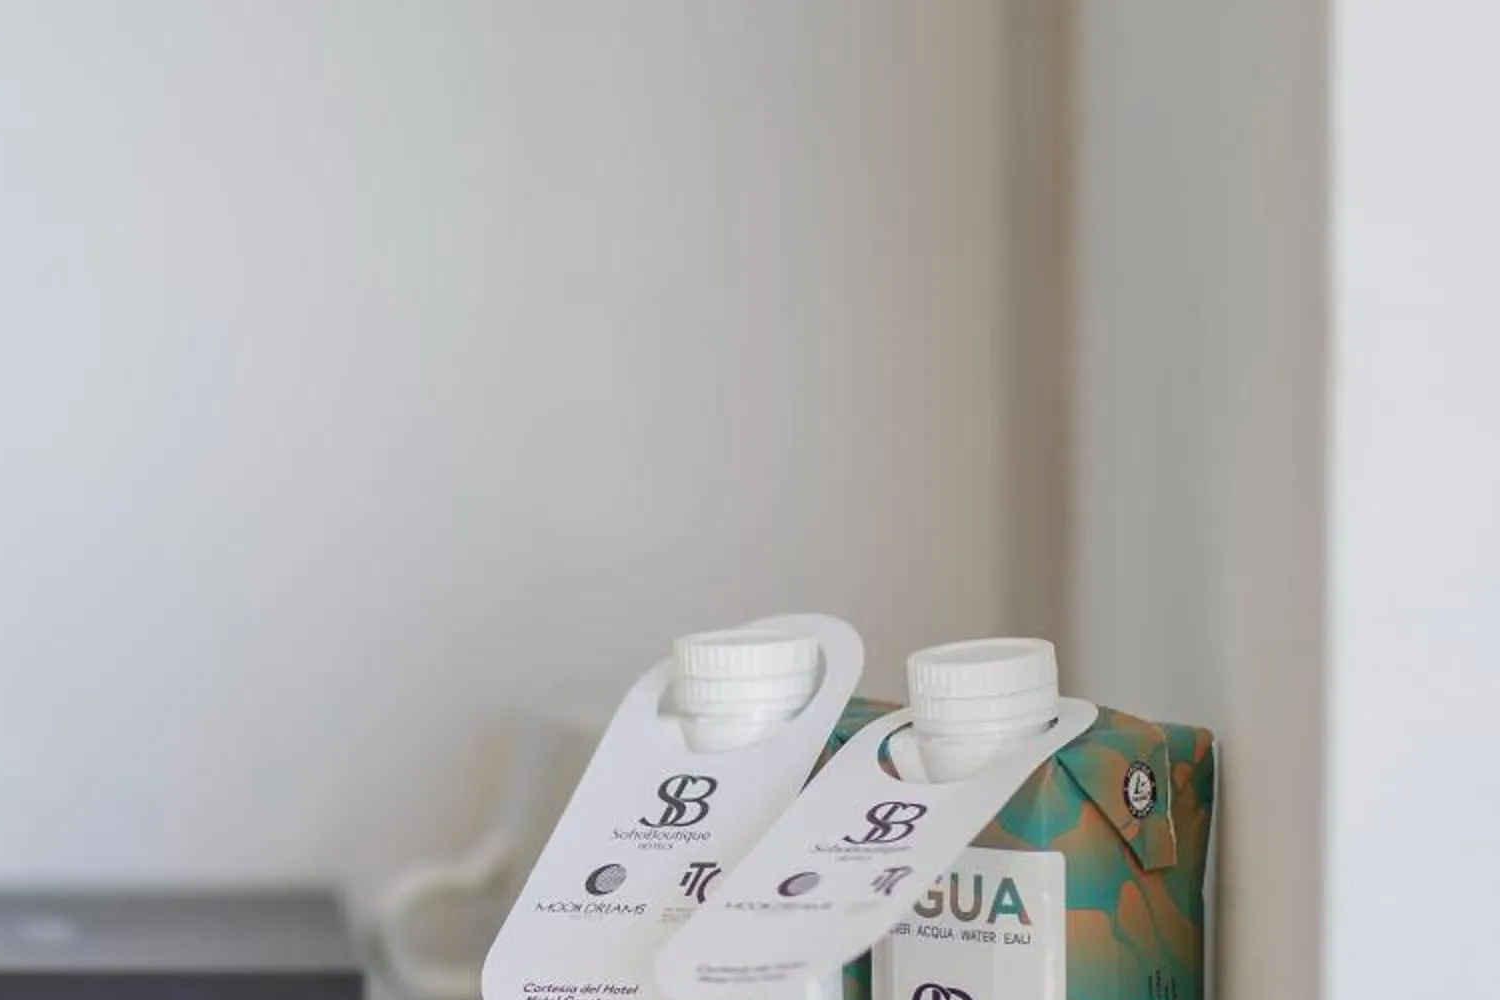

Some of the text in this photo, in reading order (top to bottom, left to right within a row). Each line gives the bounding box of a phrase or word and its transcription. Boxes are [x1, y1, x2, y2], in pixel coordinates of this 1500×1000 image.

[612, 828, 712, 843] SohoBoutique
[912, 872, 1033, 926] GUA
[534, 902, 582, 914] MOON
[583, 903, 649, 915] DREAMS
[916, 925, 954, 941] ACQUA
[960, 929, 997, 944] WATER
[1003, 933, 1032, 945] EAU
[579, 983, 601, 994] del
[602, 985, 639, 995] Hotel
